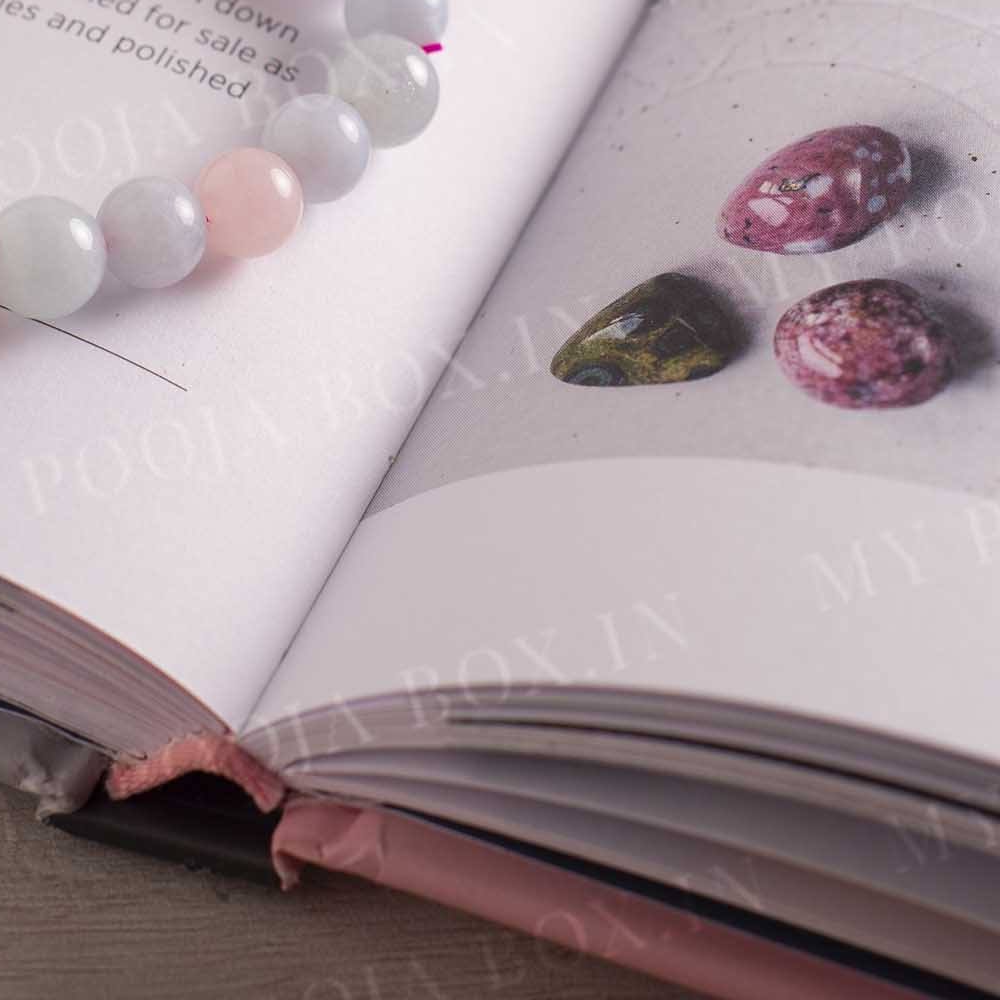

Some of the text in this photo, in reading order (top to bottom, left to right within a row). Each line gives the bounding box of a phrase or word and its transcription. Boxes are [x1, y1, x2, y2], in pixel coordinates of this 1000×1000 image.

[47, 10, 112, 46] and
[111, 32, 253, 101] polished
[143, 3, 193, 35] for
[195, 23, 258, 64] sale
[263, 60, 300, 88] as
